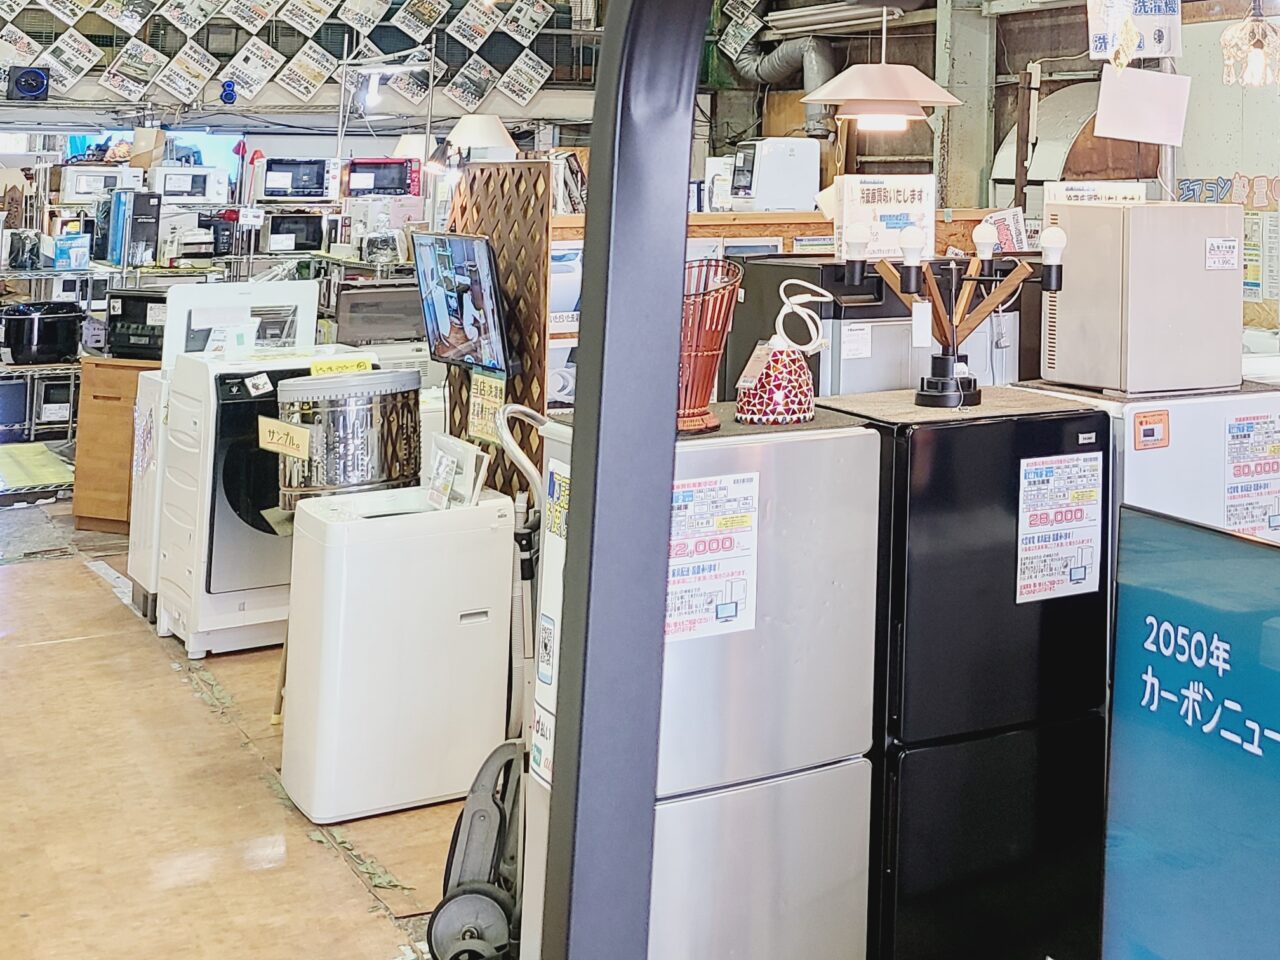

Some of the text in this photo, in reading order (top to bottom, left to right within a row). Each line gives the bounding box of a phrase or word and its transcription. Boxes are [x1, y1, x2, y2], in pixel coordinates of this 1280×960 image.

[1233, 461, 1280, 478] 30,000
[1028, 508, 1084, 527] 28,000
[1144, 615, 1231, 677] 2050年
